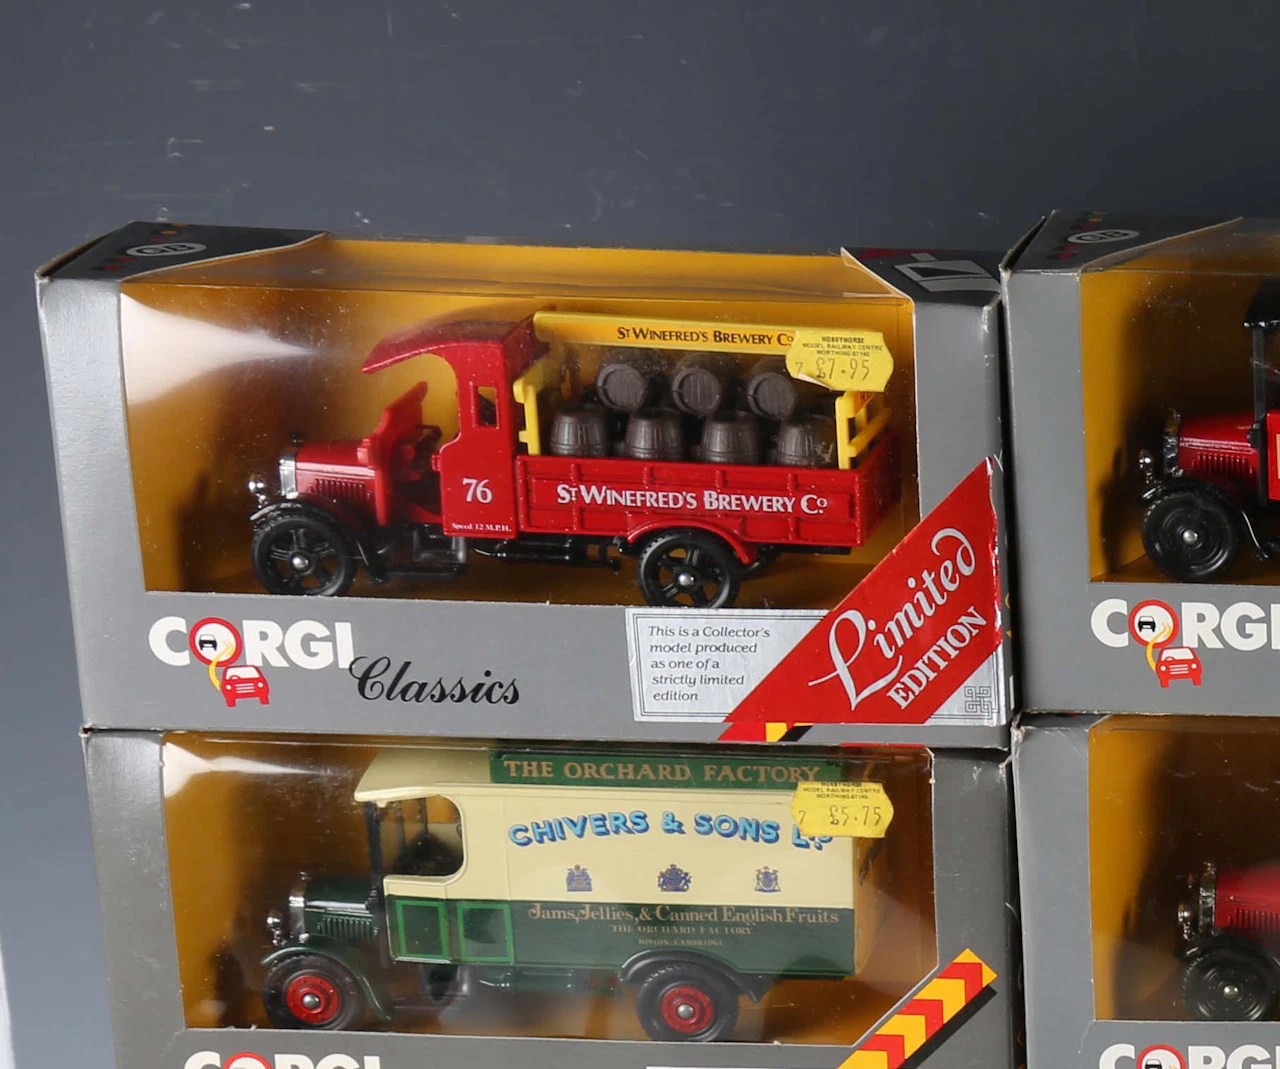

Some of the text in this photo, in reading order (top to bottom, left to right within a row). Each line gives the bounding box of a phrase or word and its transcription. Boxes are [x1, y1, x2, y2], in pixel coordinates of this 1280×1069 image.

[713, 330, 774, 346] BREWERY
[463, 478, 492, 503] 76
[579, 485, 697, 510] WINEFRED'S
[703, 488, 795, 513] BREWERY
[809, 527, 976, 710] Limited
[148, 615, 355, 669] CORGI
[648, 625, 770, 638] This is a Collector's
[650, 642, 757, 656] model produced
[886, 605, 987, 709] EDITION
[651, 659, 666, 670] as
[668, 659, 693, 670] one
[349, 656, 520, 704] Classics
[652, 674, 744, 689] strictly limited
[653, 690, 698, 701] edition
[504, 761, 820, 783] THE ORCHARD FACTORY
[508, 811, 650, 847] CHIVERS
[660, 810, 688, 835] &
[694, 813, 781, 844] SONS
[654, 905, 718, 922] Canned
[784, 908, 839, 923] Fruits
